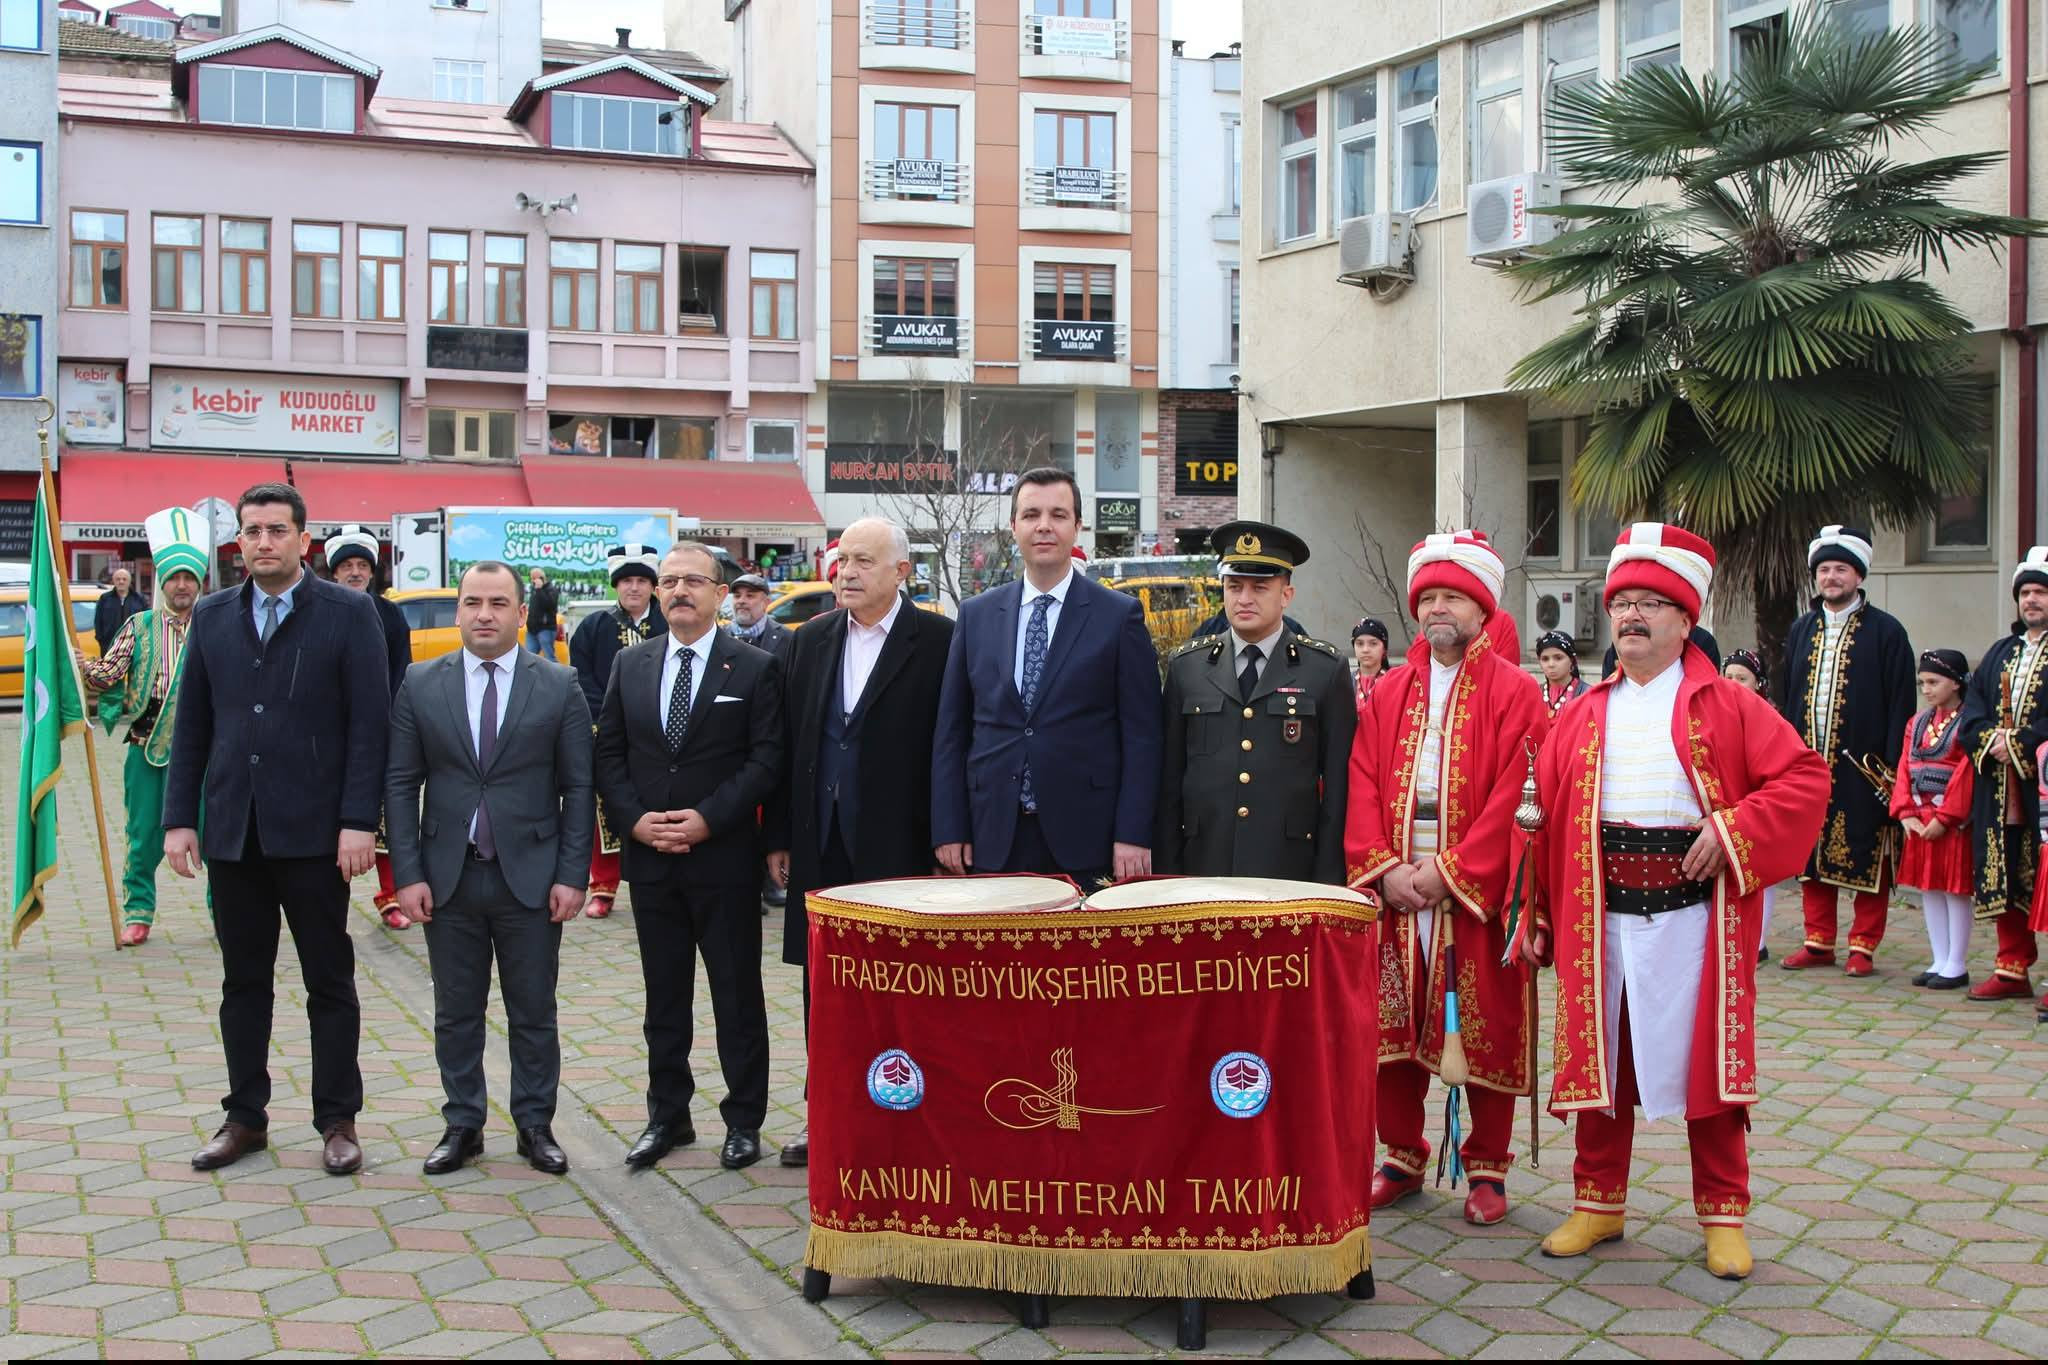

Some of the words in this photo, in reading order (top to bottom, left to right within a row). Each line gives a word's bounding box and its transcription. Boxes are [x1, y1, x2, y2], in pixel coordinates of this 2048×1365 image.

[898, 161, 940, 172] AVUKAT
[1512, 184, 1524, 239] VESTEL
[893, 323, 946, 336] AVUKAT
[1052, 328, 1104, 342] AVUKAT
[74, 367, 110, 380] kebir
[192, 387, 263, 413] kebir
[280, 390, 376, 412] KUDUOĞLU
[291, 413, 364, 433] MARKET
[830, 462, 899, 480] NURCAN
[1186, 462, 1238, 482] TOP
[827, 953, 946, 997] TRABZON
[953, 958, 1131, 1007] BÜYÜKŞEHİR
[1138, 947, 1311, 996] BELEDİYESİ
[839, 1164, 952, 1205] KANUNİ
[970, 1177, 1166, 1216] MEHTERAN
[1186, 1176, 1302, 1216] TAKIMI
